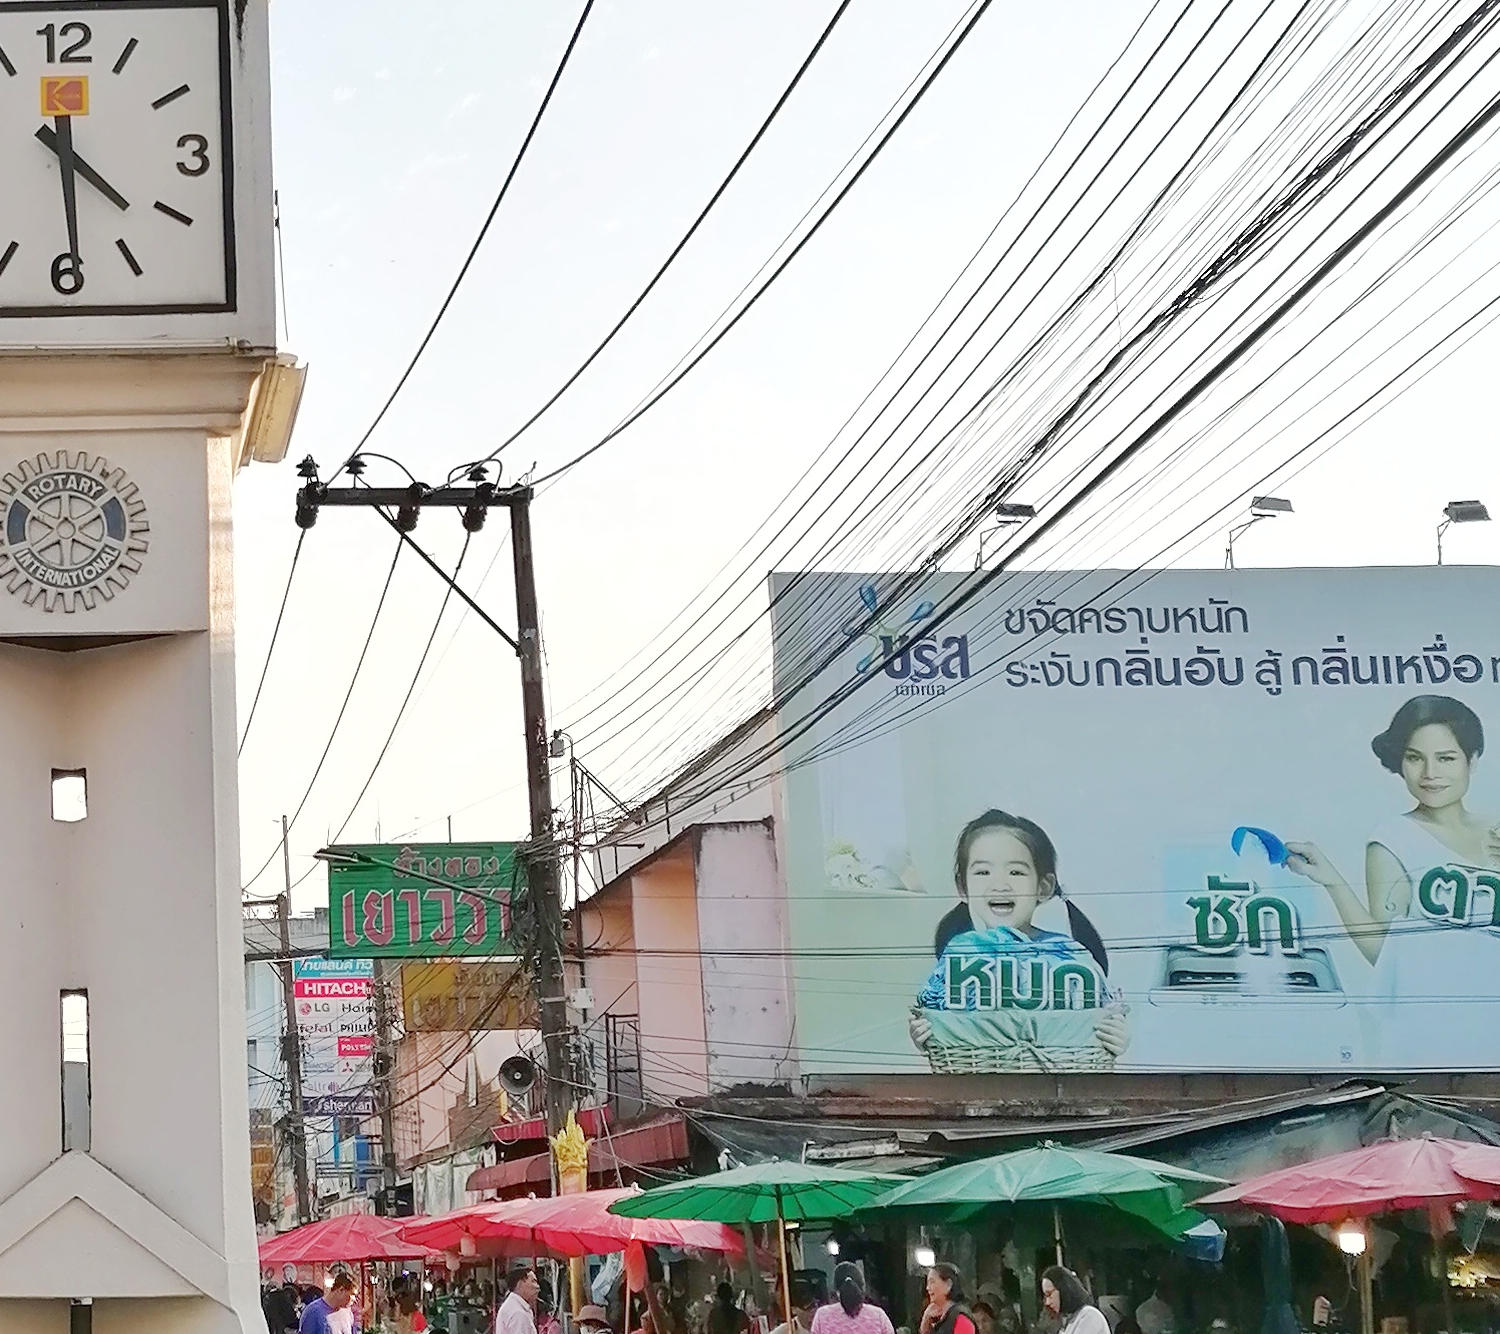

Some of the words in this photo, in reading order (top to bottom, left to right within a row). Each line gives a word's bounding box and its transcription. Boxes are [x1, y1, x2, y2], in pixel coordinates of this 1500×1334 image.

[36, 22, 93, 63] 12
[176, 133, 211, 177] 3
[50, 252, 84, 295] 6
[28, 474, 104, 501] ROTARY
[14, 547, 119, 586] INTERNATIONAL
[1004, 598, 1249, 634] ขจัดคราบหนัก
[1005, 636, 1244, 687] ระงับกลิ่นอับ
[1291, 634, 1484, 686] กลิ่นเหงื่อ
[342, 888, 528, 947] เยาวรา
[314, 1003, 330, 1012] LG
[342, 1003, 377, 1013] Hai
